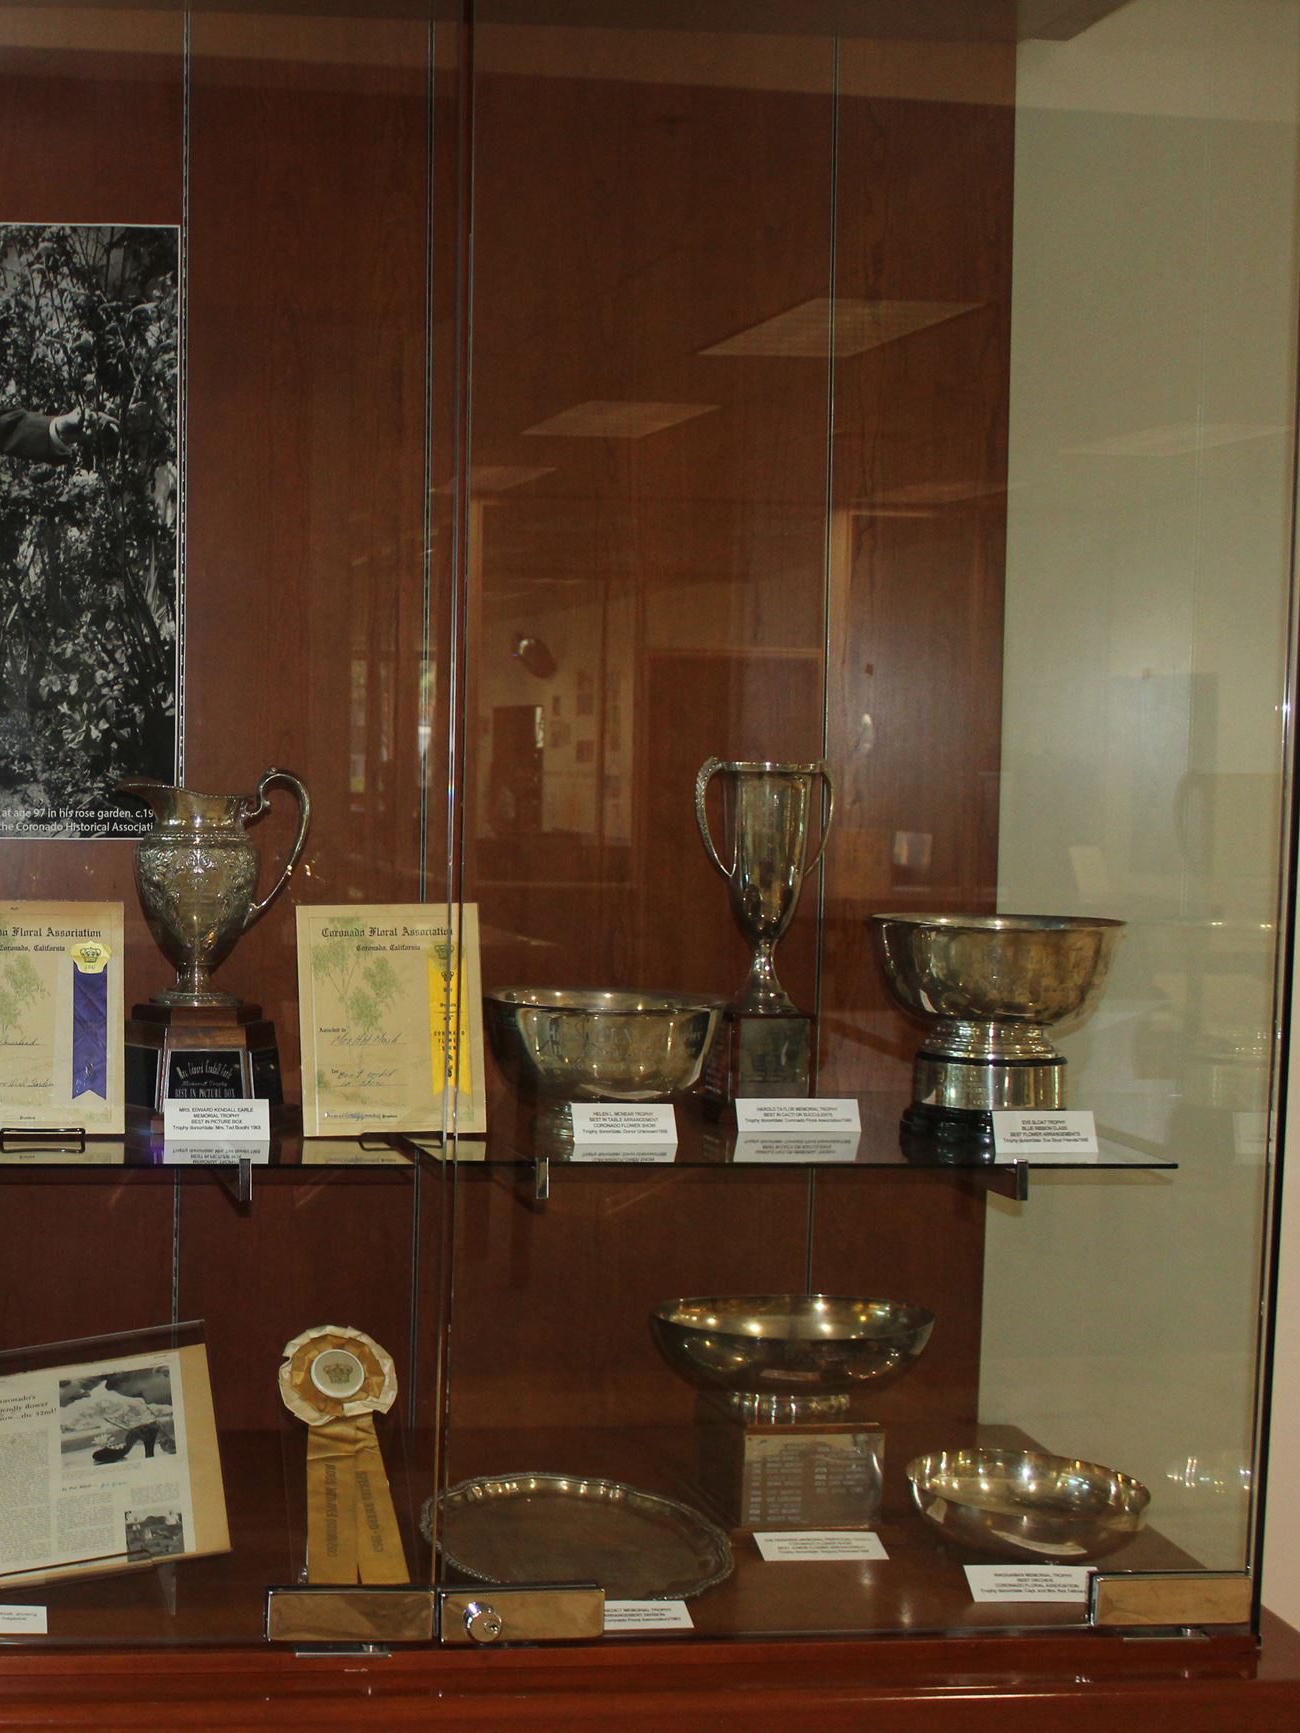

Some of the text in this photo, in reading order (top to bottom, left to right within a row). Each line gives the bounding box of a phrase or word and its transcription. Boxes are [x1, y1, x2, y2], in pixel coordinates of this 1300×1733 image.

[2, 809, 11, 817] at
[13, 810, 31, 820] age
[34, 809, 44, 817] 97
[48, 809, 56, 817] in
[60, 808, 73, 817] his
[98, 808, 133, 820] garden.
[16, 822, 63, 831] Coronado
[66, 822, 109, 831] Historical
[12, 927, 42, 937] Floral
[46, 927, 101, 938] Association
[321, 928, 365, 937] Coronado
[369, 928, 397, 937] Floral
[33, 944, 65, 952] California
[175, 1088, 188, 1097] BEST
[199, 1088, 221, 1097] PICTURE
[224, 1088, 235, 1097] BOX
